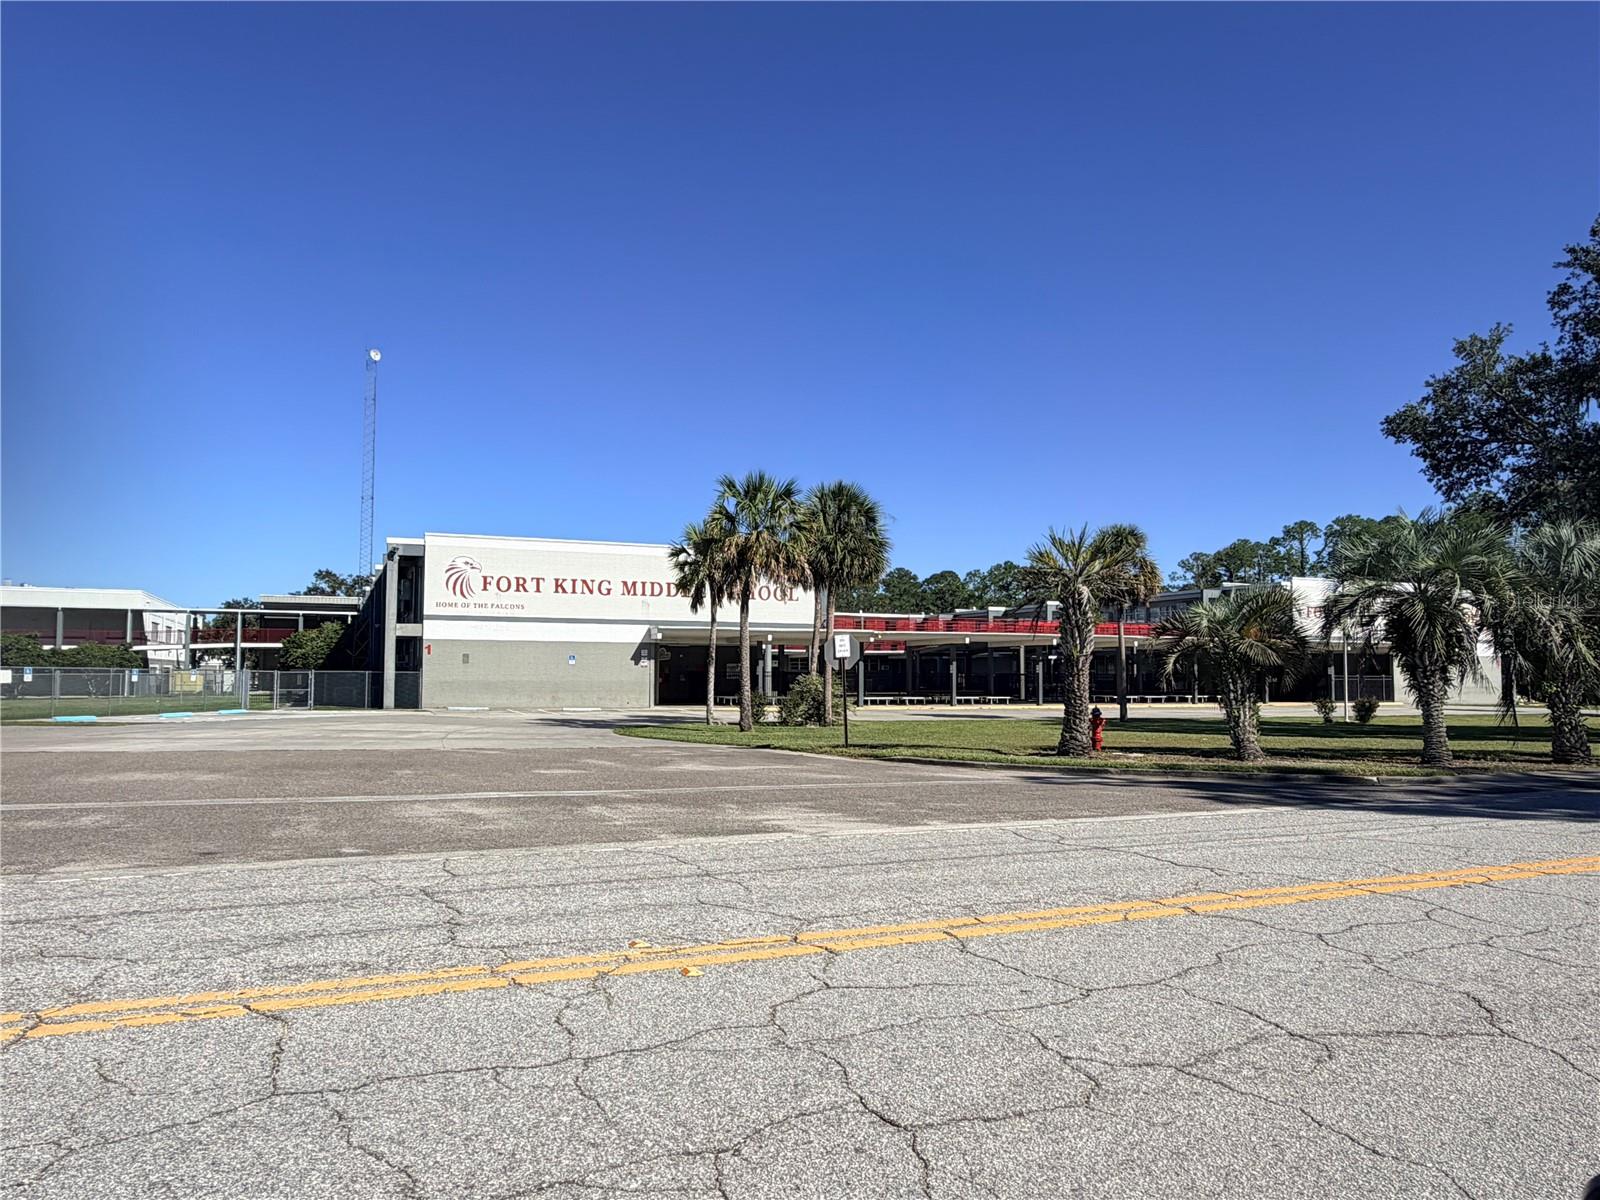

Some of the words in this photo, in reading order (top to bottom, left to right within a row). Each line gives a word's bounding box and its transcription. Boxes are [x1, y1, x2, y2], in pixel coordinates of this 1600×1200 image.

[481, 575, 546, 593] FORT
[553, 577, 612, 596] KING
[620, 580, 707, 598] MIDDL
[435, 601, 459, 609] HOME
[490, 602, 525, 610] FALCONS
[424, 643, 433, 656] 1
